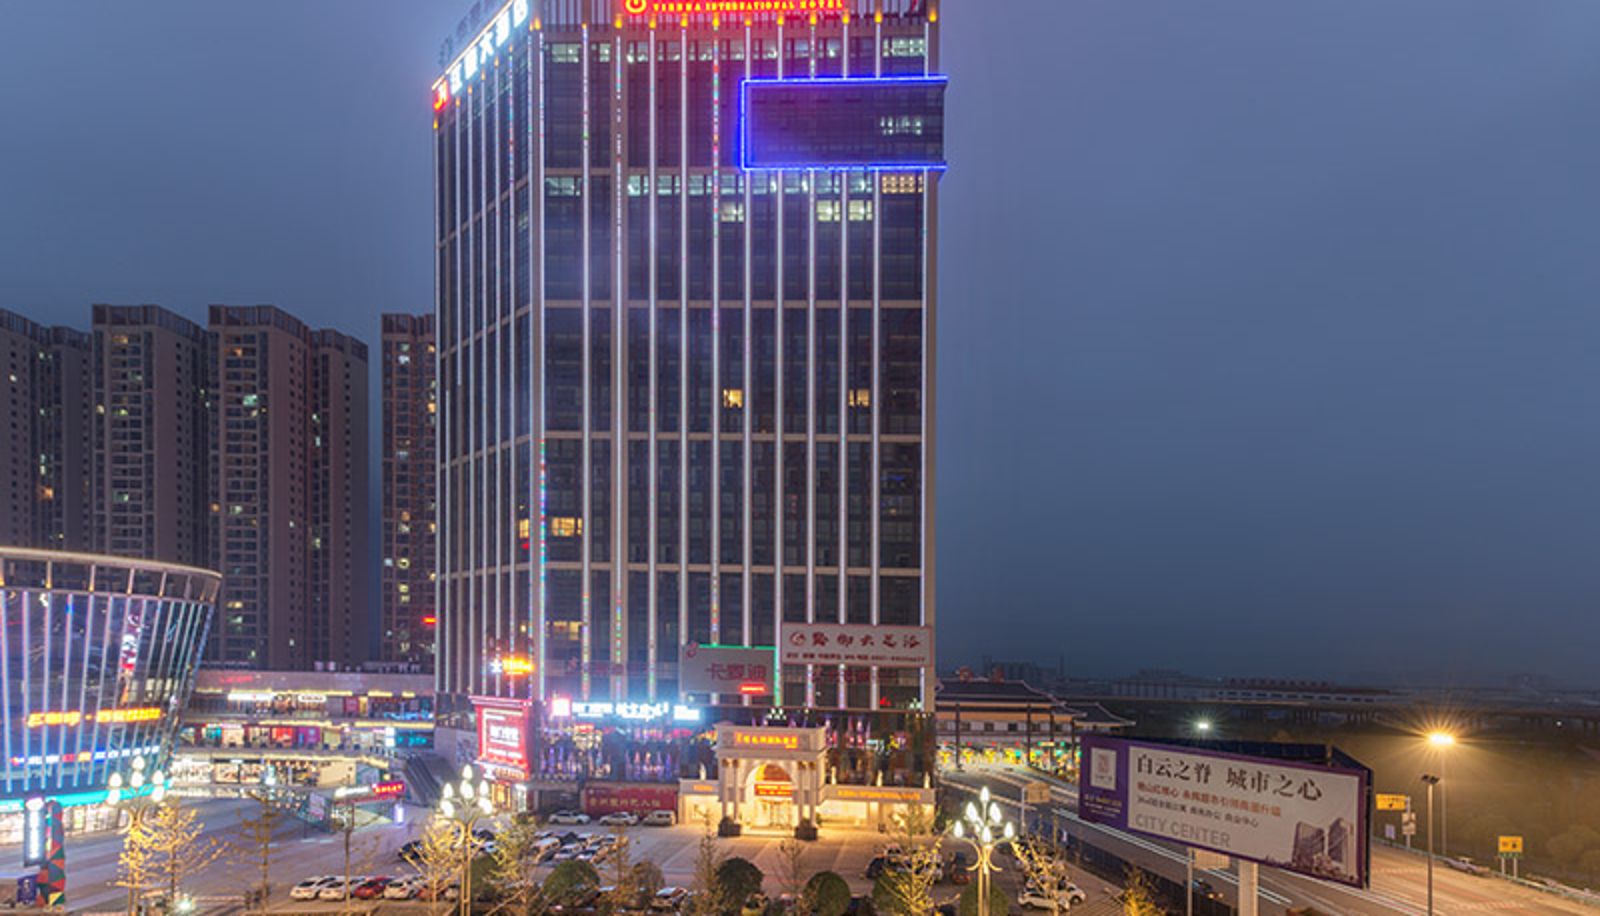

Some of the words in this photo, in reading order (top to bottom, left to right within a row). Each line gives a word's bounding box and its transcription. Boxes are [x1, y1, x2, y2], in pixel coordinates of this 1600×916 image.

[705, 2, 795, 11] INTERNATIONAL
[800, 0, 843, 9] HOTEL
[1136, 753, 1212, 784] 白云之脊
[1226, 767, 1323, 801] 城市之心
[1135, 813, 1169, 832] CITY
[1170, 819, 1232, 848] CENTER
